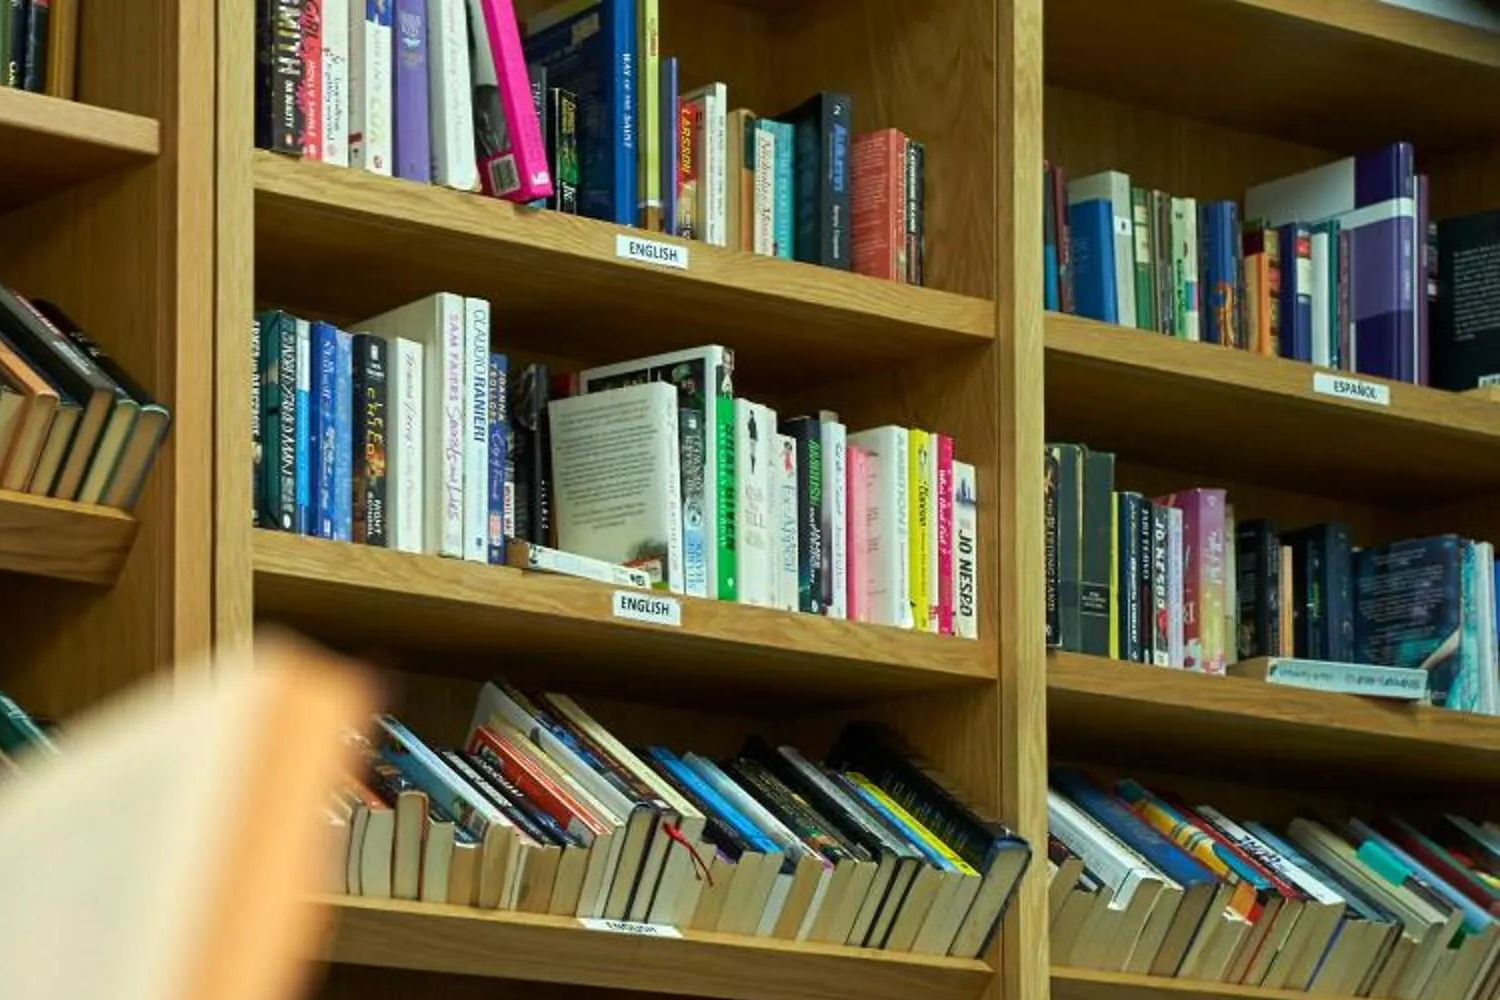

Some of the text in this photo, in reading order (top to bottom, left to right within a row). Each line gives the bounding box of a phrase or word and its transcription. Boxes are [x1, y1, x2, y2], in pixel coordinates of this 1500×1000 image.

[276, 0, 302, 75] MITH
[680, 107, 693, 173] LARSSON
[629, 240, 679, 262] ENGLISH
[472, 309, 488, 442] CLAUDIO RANIERI
[1332, 380, 1378, 400] ESPAÑOL
[958, 528, 972, 553] JO
[1155, 517, 1165, 541] JO
[621, 597, 670, 617] ENGLISH
